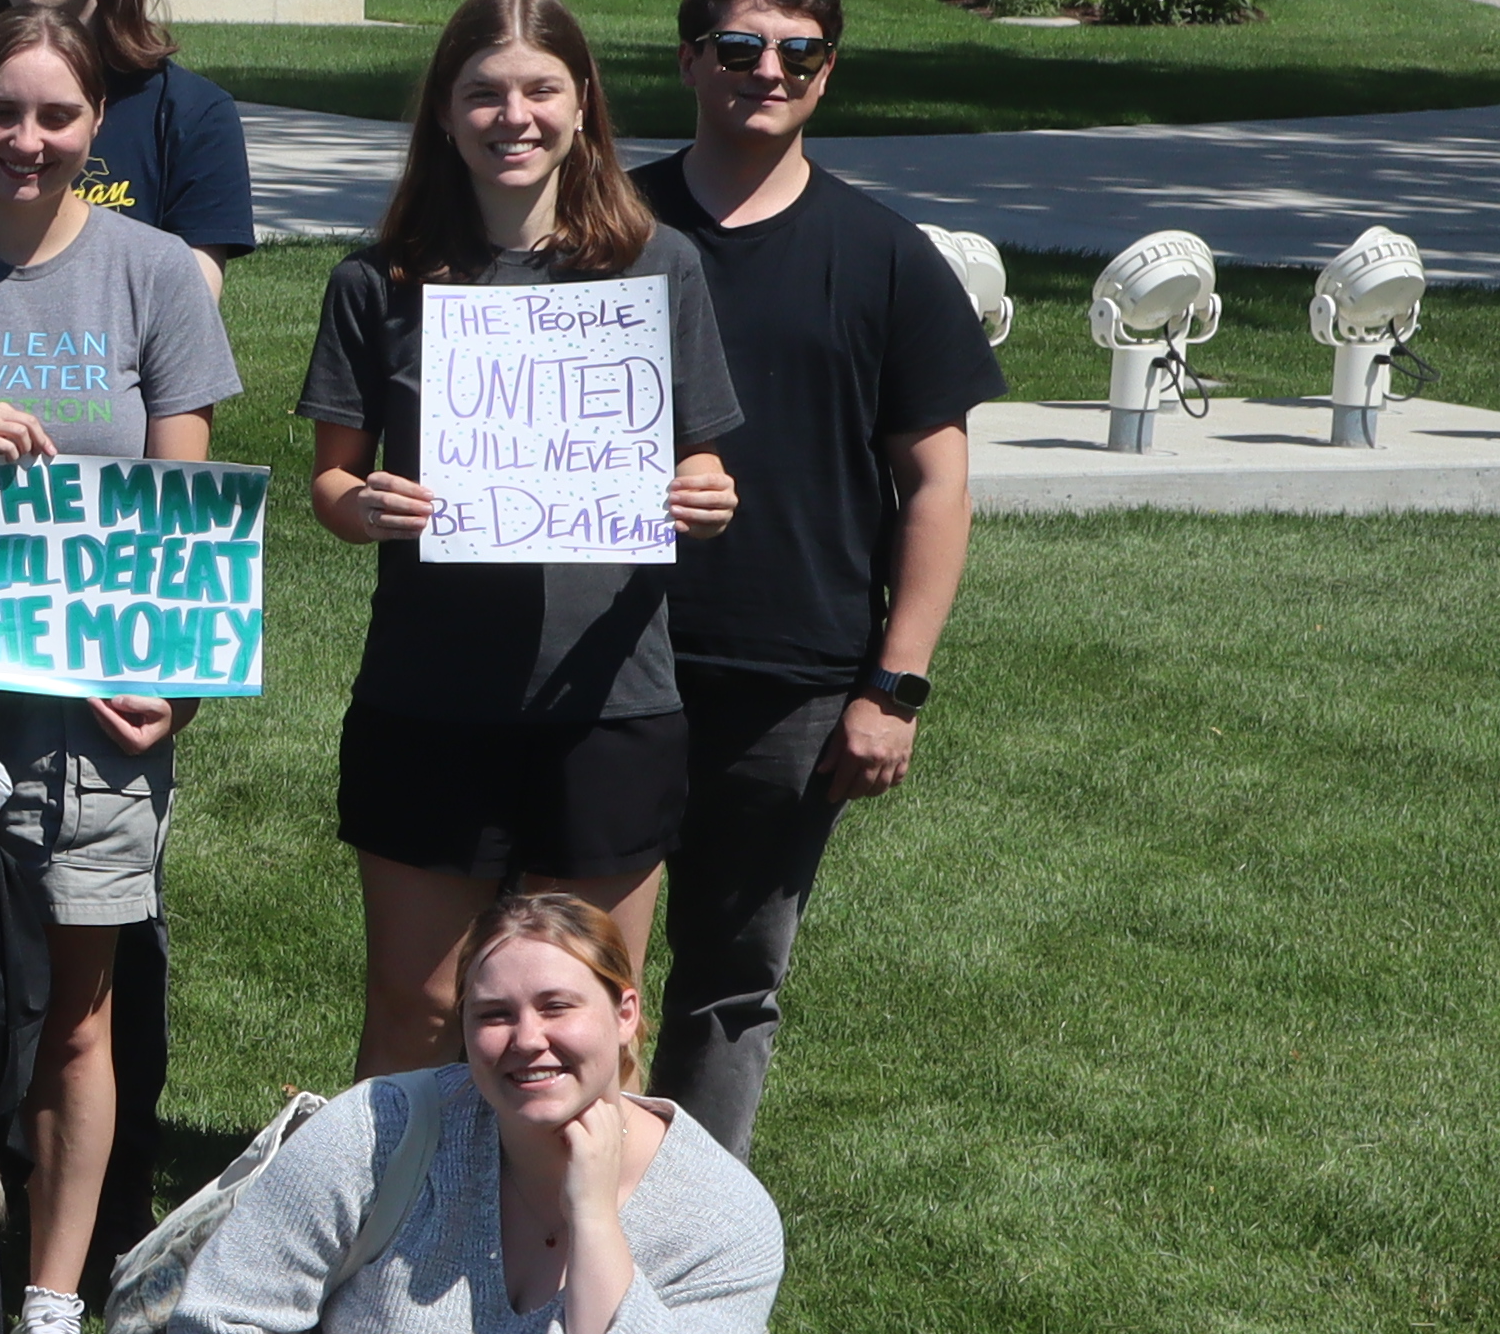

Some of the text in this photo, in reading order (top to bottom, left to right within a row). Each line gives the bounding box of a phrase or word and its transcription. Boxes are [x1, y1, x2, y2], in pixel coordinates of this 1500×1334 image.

[428, 294, 646, 340] THE PEOPLE
[447, 348, 665, 434] UNITED
[438, 428, 667, 473] WILL NEVER
[100, 462, 269, 542] MANY
[431, 497, 487, 537] BE
[61, 530, 262, 605] DEFEAT
[66, 598, 264, 685] MONEY
